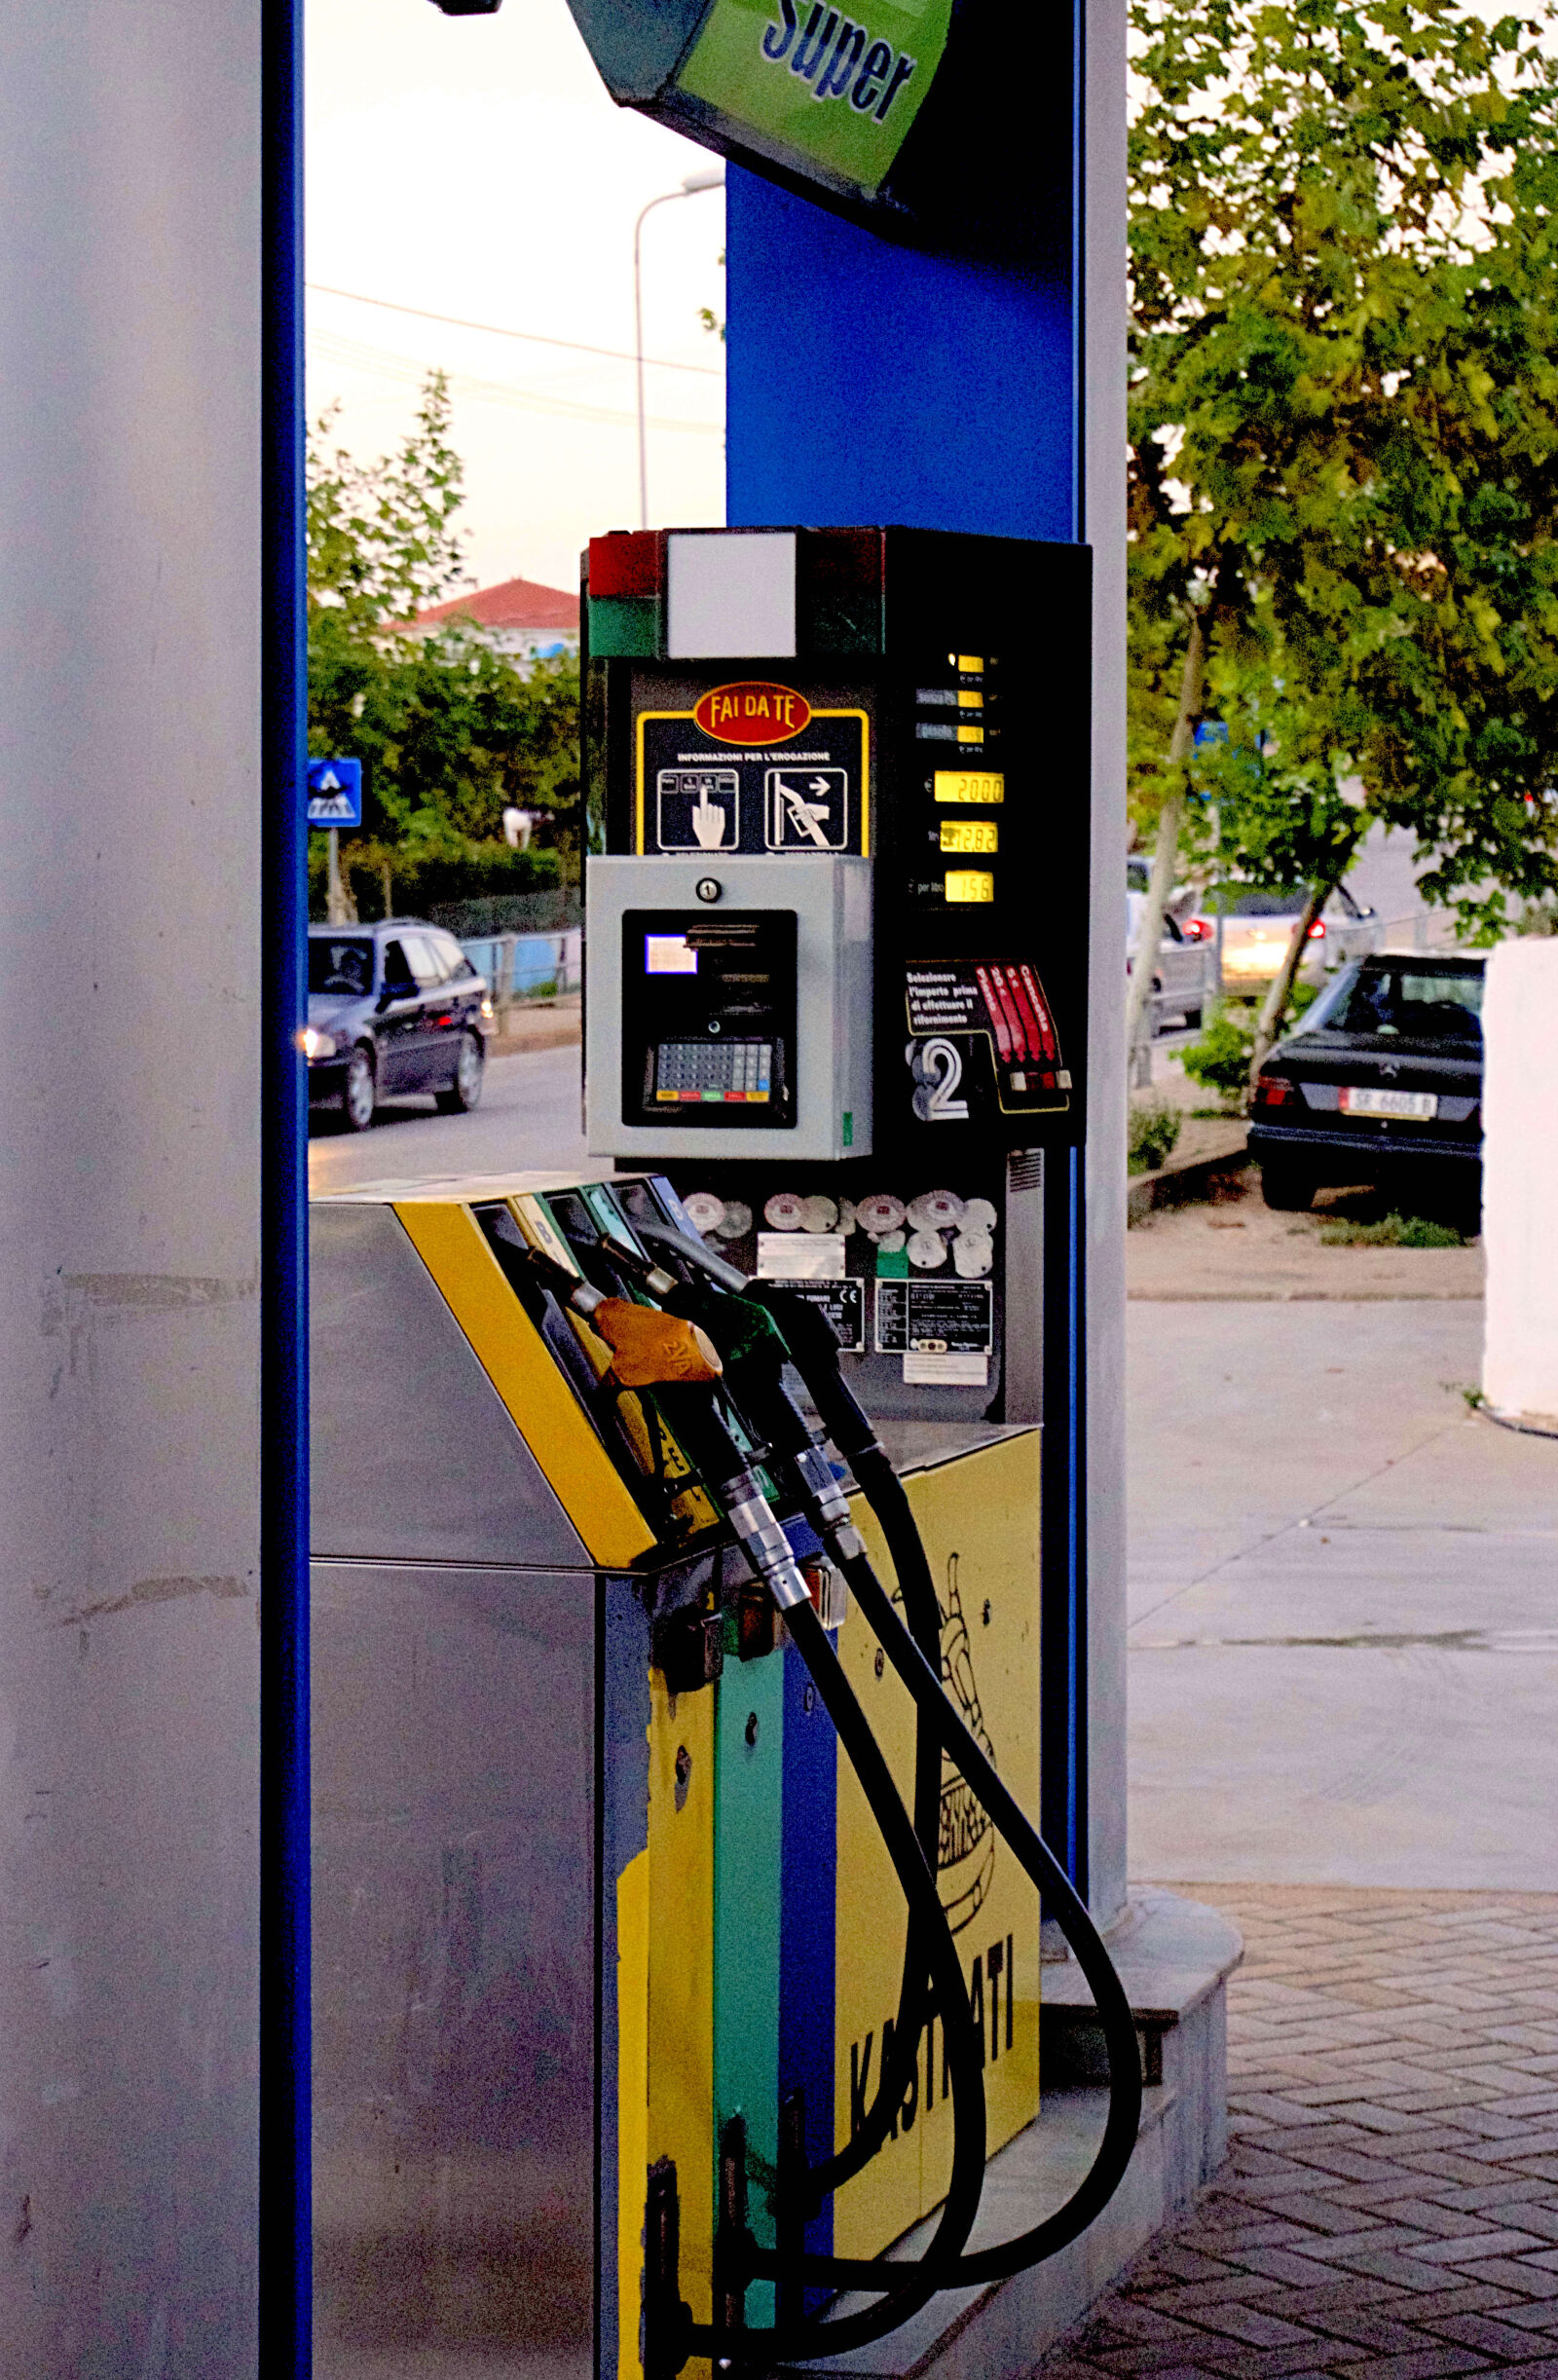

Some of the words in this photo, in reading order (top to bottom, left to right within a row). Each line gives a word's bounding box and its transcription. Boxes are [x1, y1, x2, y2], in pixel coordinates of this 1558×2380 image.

[760, 0, 917, 125] Super
[711, 694, 738, 727] FAI
[745, 694, 770, 718] DA
[773, 694, 797, 728] TE
[677, 752, 743, 762] INFORMAZIONI
[744, 752, 763, 762] PER
[764, 751, 831, 762] L'EROGAZIONE
[907, 972, 957, 984] Selezionare
[952, 985, 979, 998] prima
[1020, 965, 1048, 1032] Cancella
[910, 999, 921, 1011] di
[922, 999, 965, 1011] effettuare
[966, 998, 974, 1010] il
[913, 1014, 968, 1025] rifornimento
[921, 1037, 970, 1121] 2
[851, 1933, 1013, 2150] KTATI
